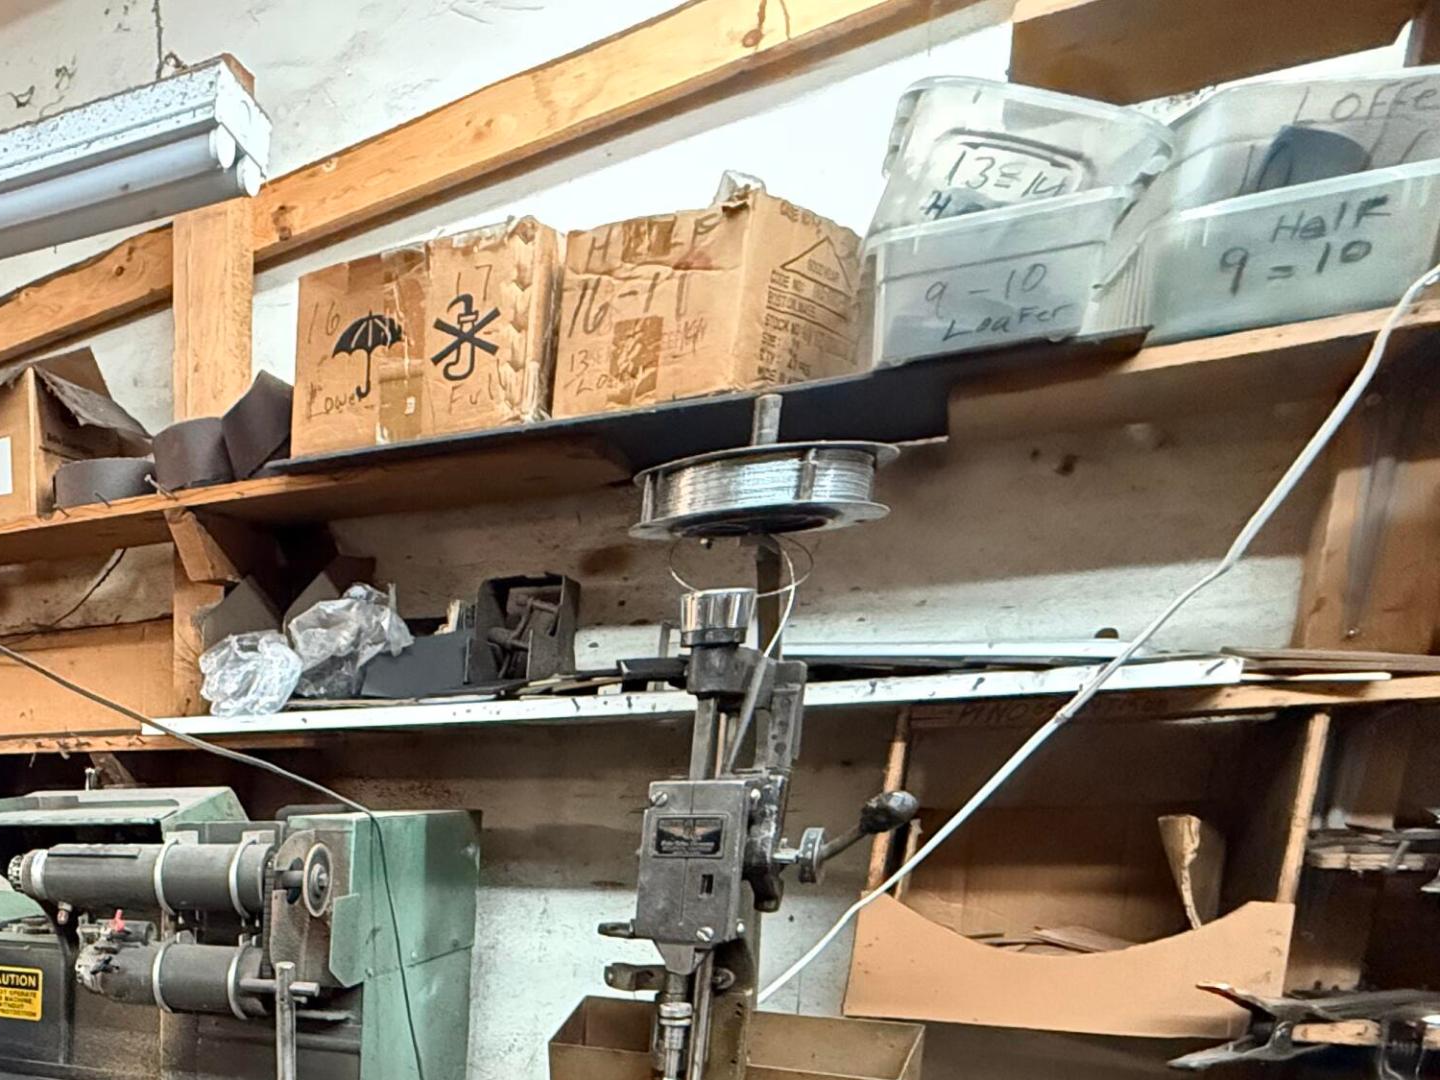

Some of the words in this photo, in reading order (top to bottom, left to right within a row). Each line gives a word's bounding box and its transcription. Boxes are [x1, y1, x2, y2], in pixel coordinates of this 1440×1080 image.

[455, 264, 494, 301] 17
[1219, 246, 1249, 297] 9
[1316, 239, 1373, 274] 10
[925, 281, 949, 319] 9
[1003, 263, 1047, 300] 10
[307, 301, 341, 345] 16
[9, 990, 37, 998] OPERATE
